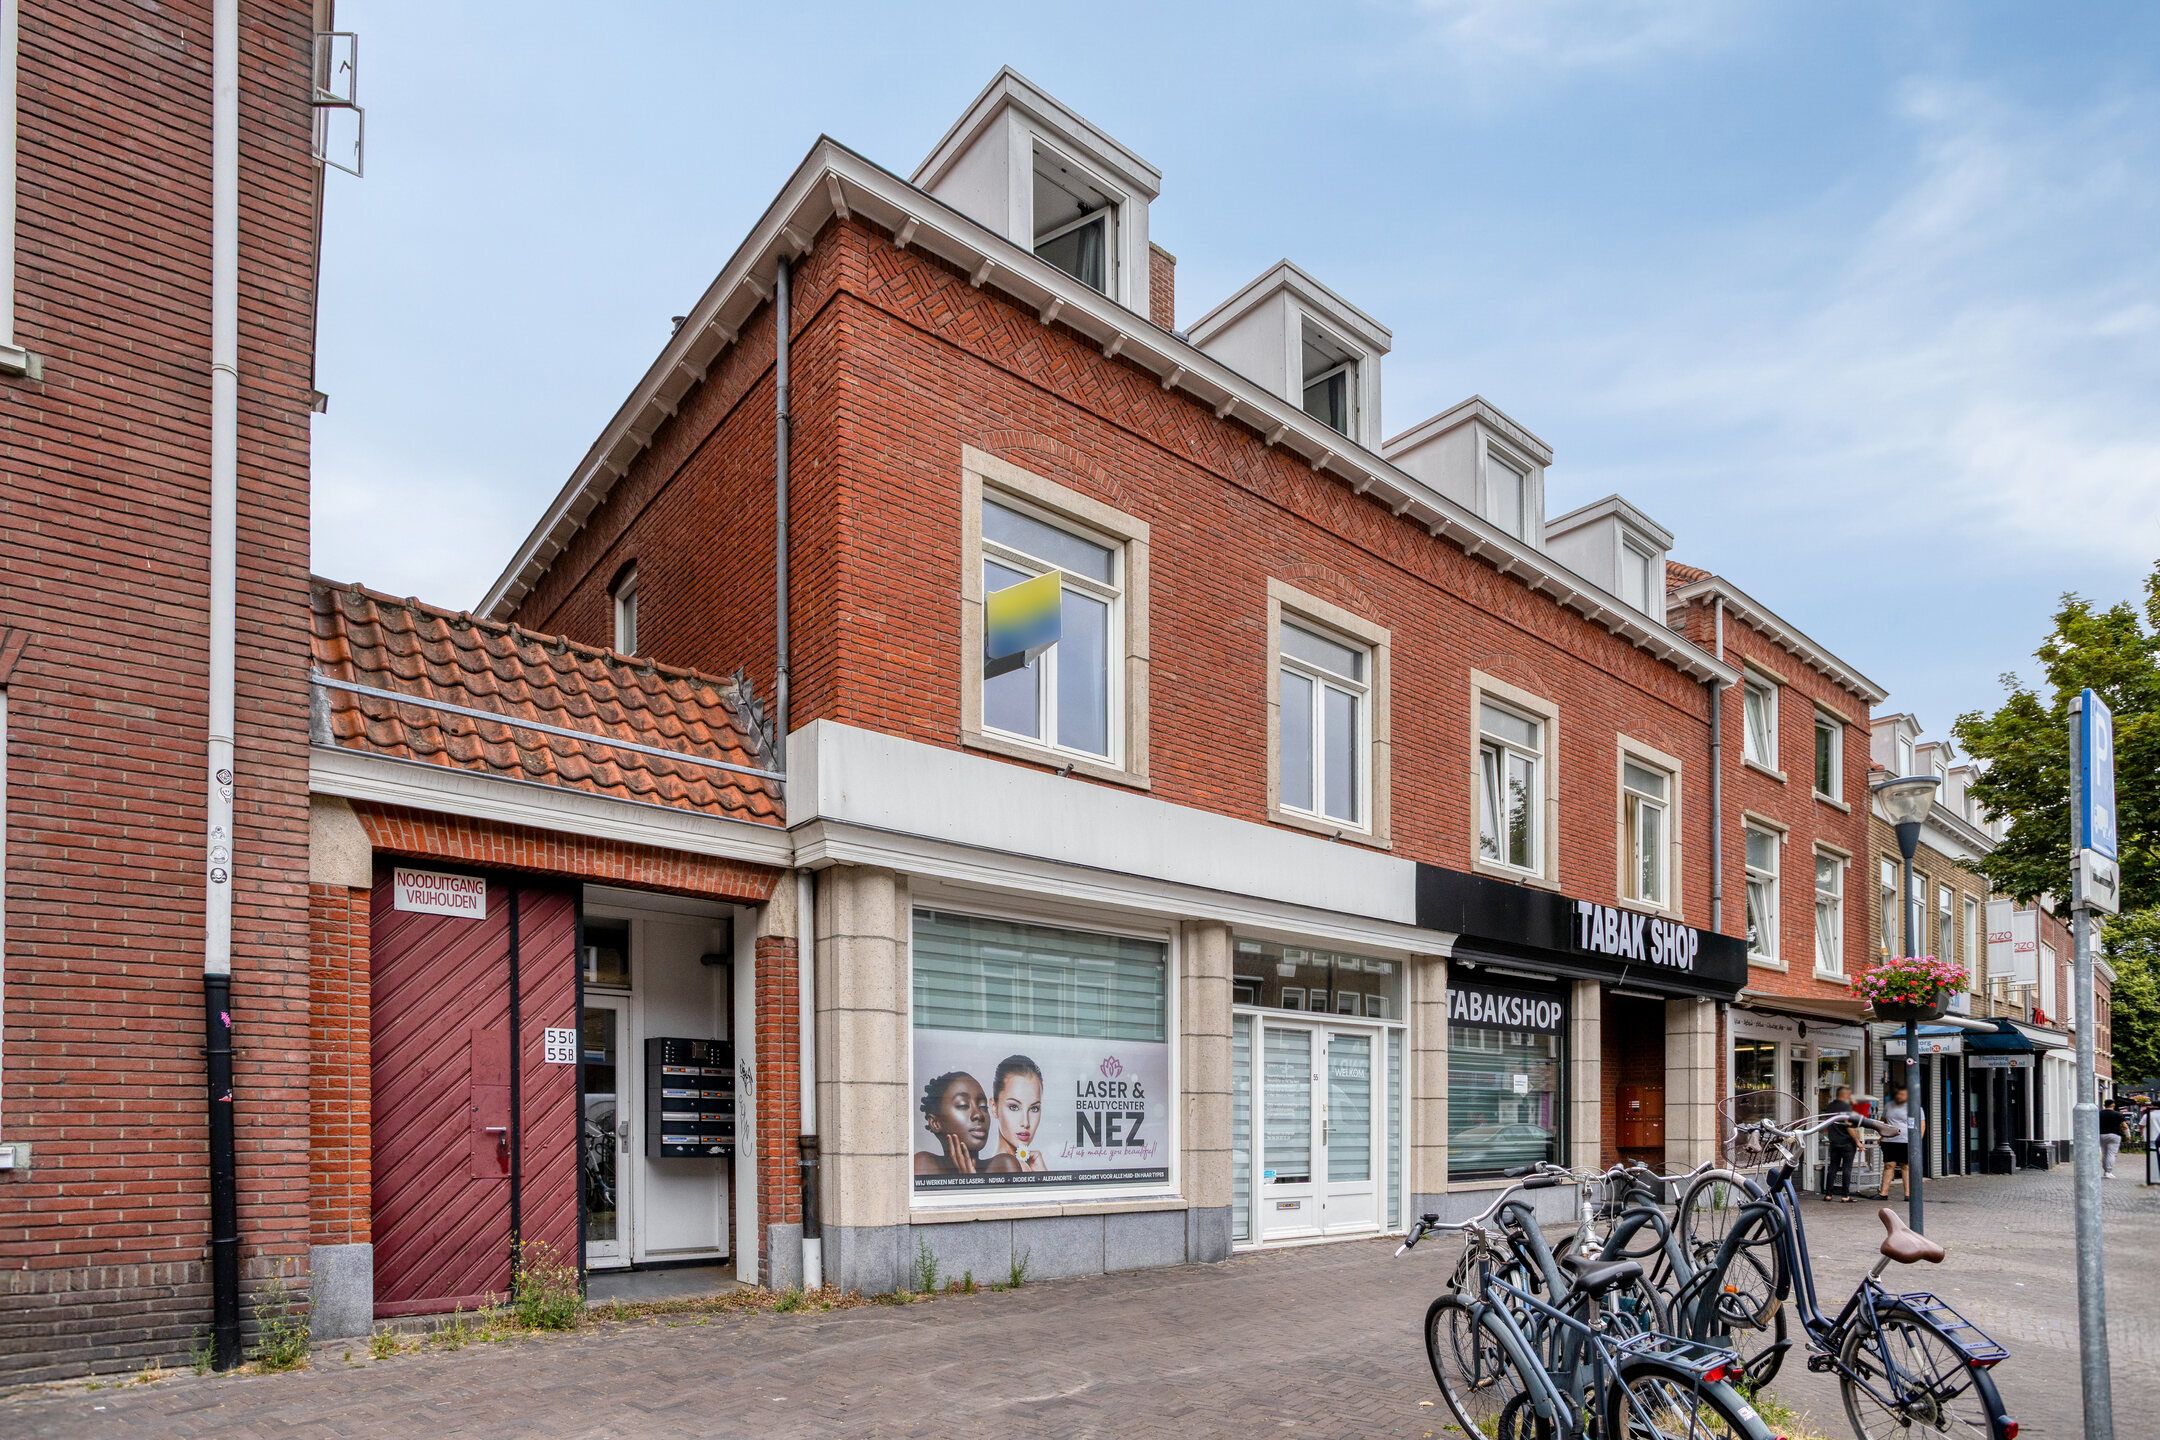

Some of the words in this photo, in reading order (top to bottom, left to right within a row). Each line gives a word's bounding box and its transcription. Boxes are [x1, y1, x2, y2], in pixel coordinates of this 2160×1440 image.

[2096, 712, 2108, 786] P
[397, 872, 484, 895] NOODUITGANG
[406, 889, 477, 909] VRIJHOUDEN
[1578, 900, 1646, 961] TABAK
[1651, 918, 1698, 971] SHOP
[1988, 931, 2013, 942] ZIZO
[1446, 988, 1561, 1029] TABAKSHOP
[547, 1030, 574, 1044] 55C
[547, 1047, 574, 1061] 55B
[1335, 1068, 1365, 1077] WELKOM
[1077, 1080, 1127, 1098] LASER
[1132, 1081, 1146, 1099] &
[1076, 1101, 1144, 1110] BEAUTYCENTER
[1076, 1111, 1145, 1148] NEZ
[1109, 1149, 1122, 1161] you
